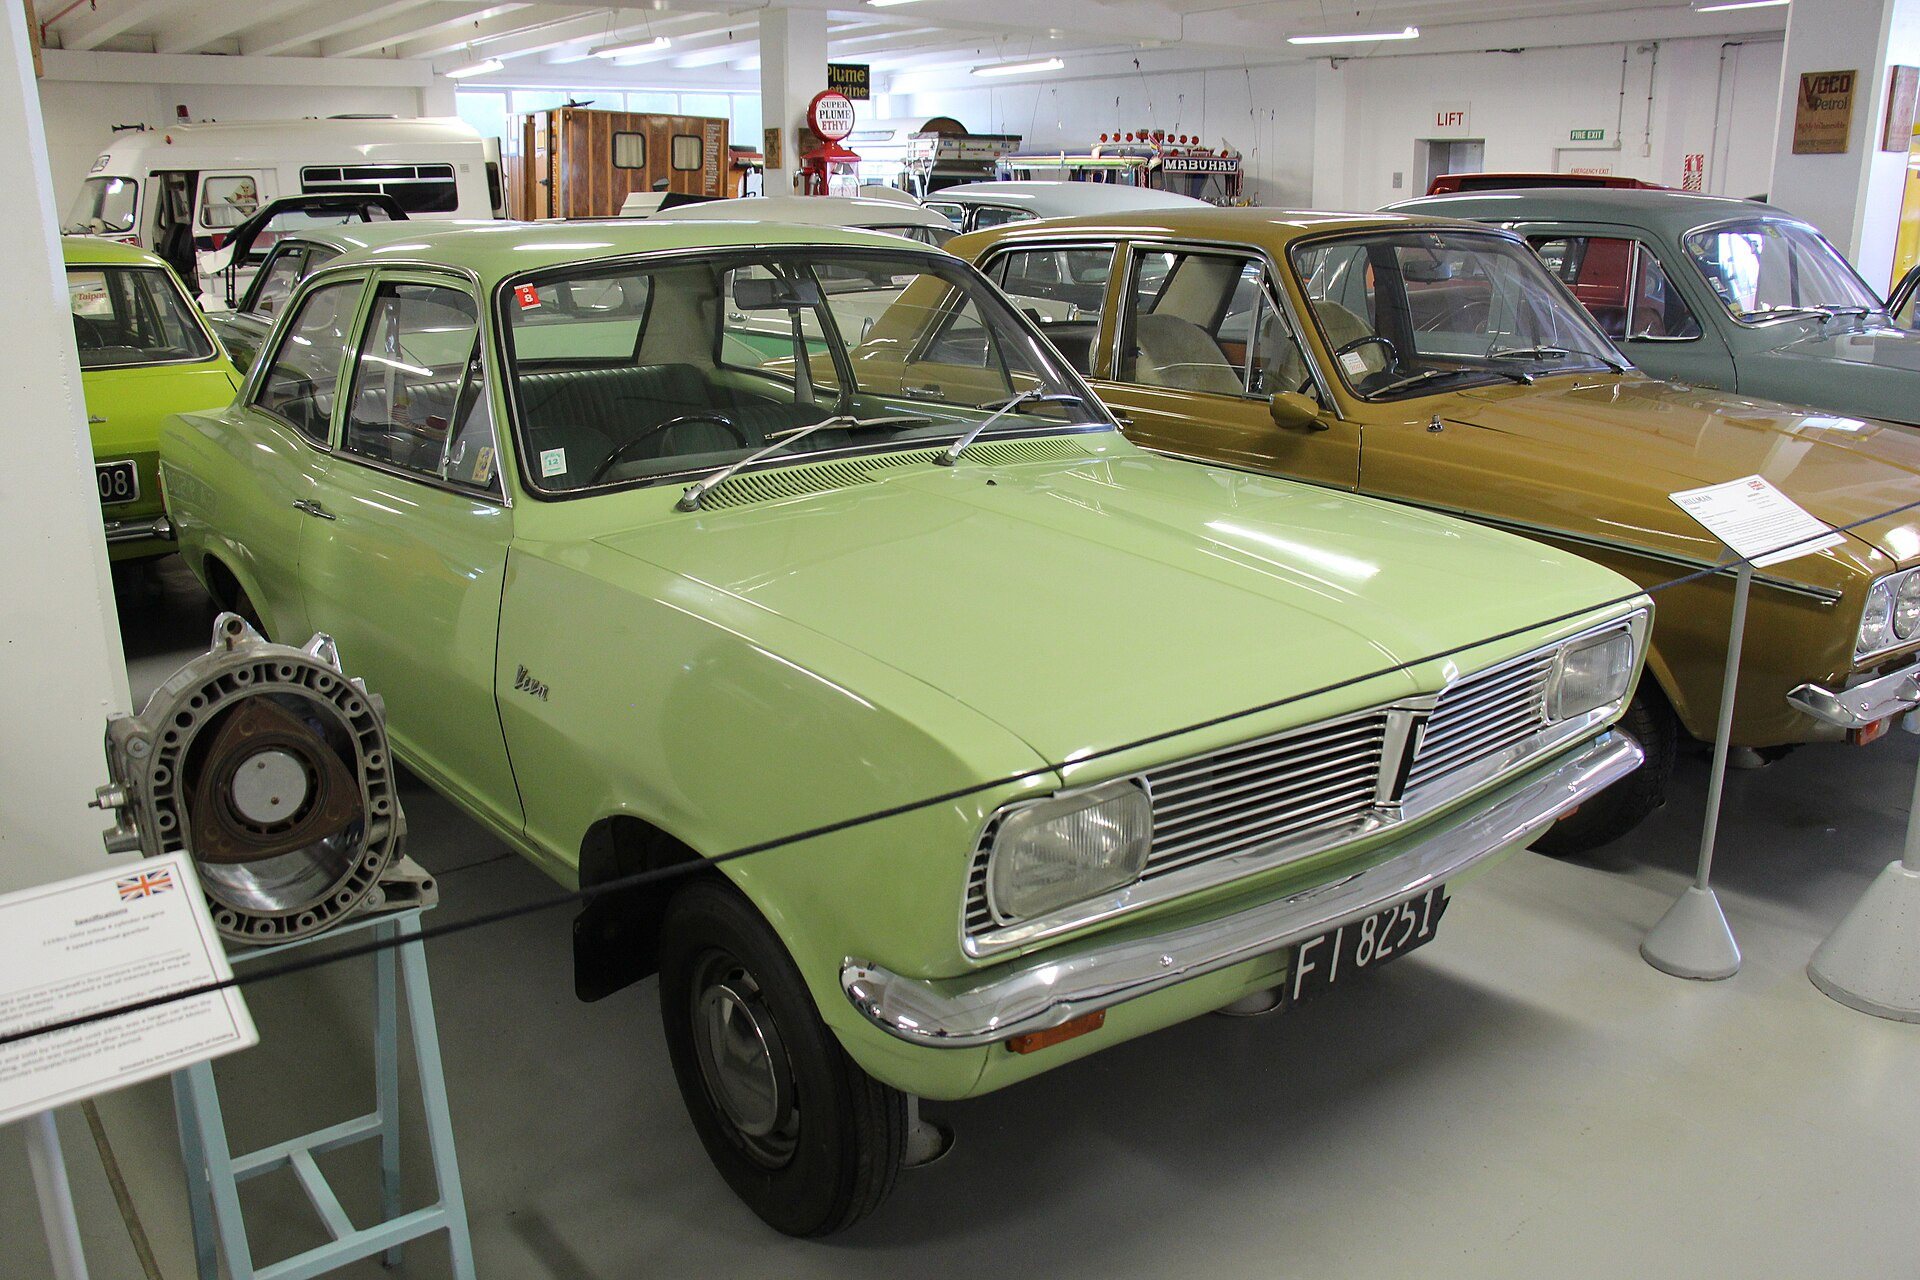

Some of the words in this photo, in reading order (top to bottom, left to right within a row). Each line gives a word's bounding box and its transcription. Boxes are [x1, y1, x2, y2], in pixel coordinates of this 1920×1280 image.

[821, 101, 848, 109] SUPER
[819, 110, 851, 119] PLUME
[1437, 112, 1464, 126] LIFT
[822, 121, 849, 130] ETHYL
[1571, 130, 1586, 139] FIRE
[1587, 130, 1602, 139] EXIT
[1165, 159, 1237, 171] MABUHAY
[79, 292, 107, 302] Taipan
[524, 294, 534, 303] 8
[547, 458, 559, 466] 12
[99, 470, 128, 497] 08
[1681, 495, 1713, 506] HILLMAN
[1355, 889, 1434, 968] 8251
